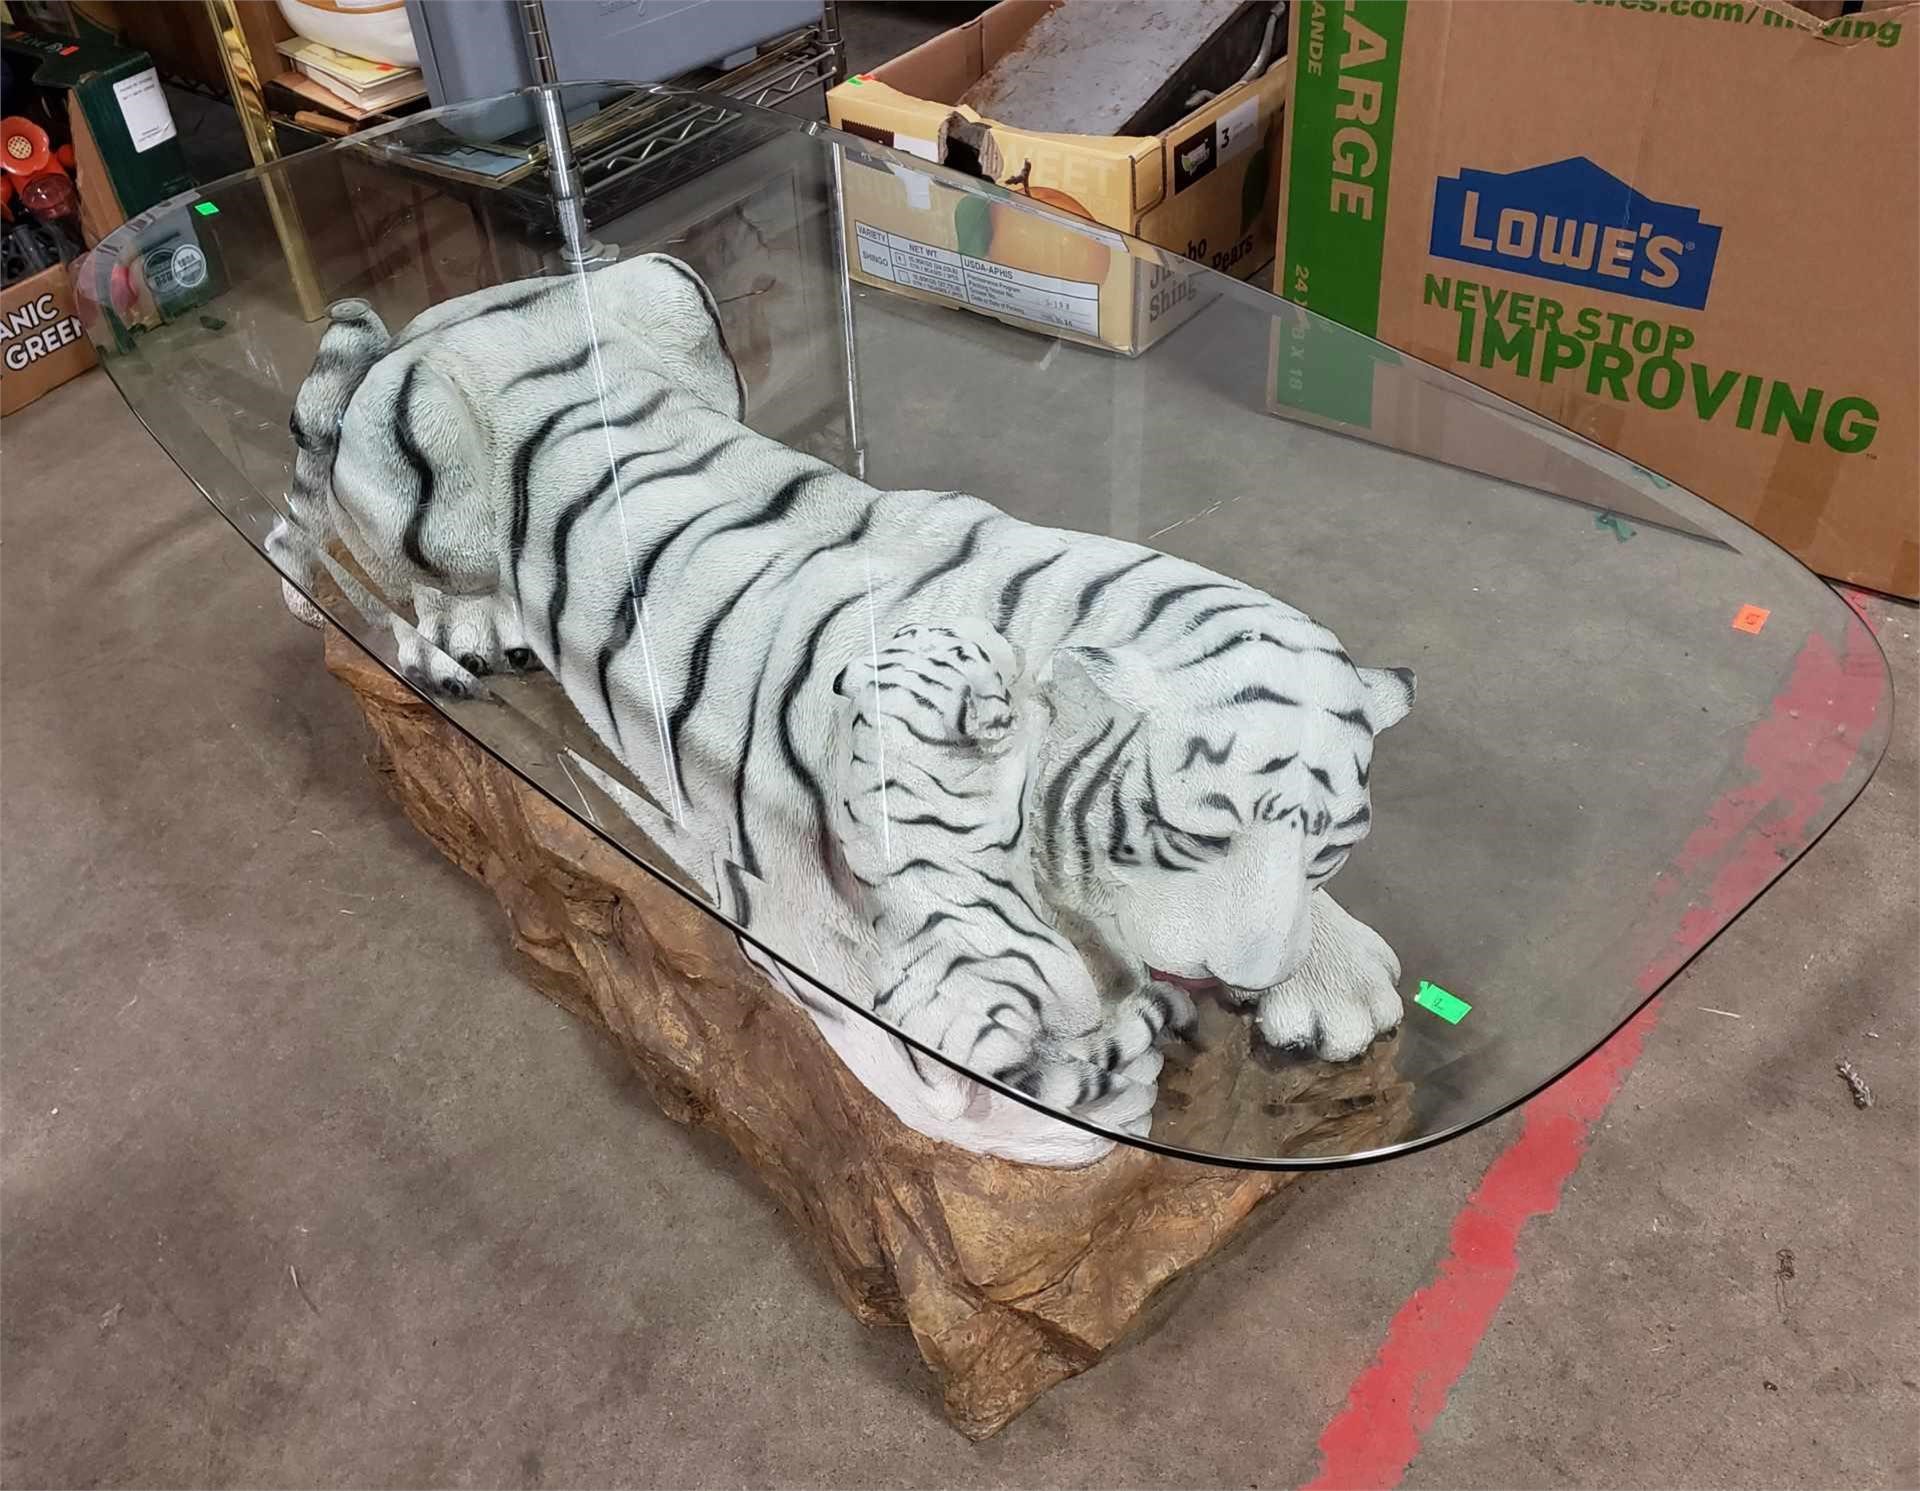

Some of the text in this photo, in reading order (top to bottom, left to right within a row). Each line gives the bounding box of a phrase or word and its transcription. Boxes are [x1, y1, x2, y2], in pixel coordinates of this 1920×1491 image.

[1330, 0, 1387, 220] ARGE
[1220, 127, 1230, 149] 3
[858, 225, 886, 242] VARIETY
[1459, 190, 1685, 289] LOWE'S
[862, 250, 889, 267] SHINGO
[909, 243, 938, 258] NET WT
[964, 258, 1014, 280] USDA-APHIS
[1423, 273, 1695, 359] NEVER STOP
[1456, 304, 1880, 455] IMPROVING
